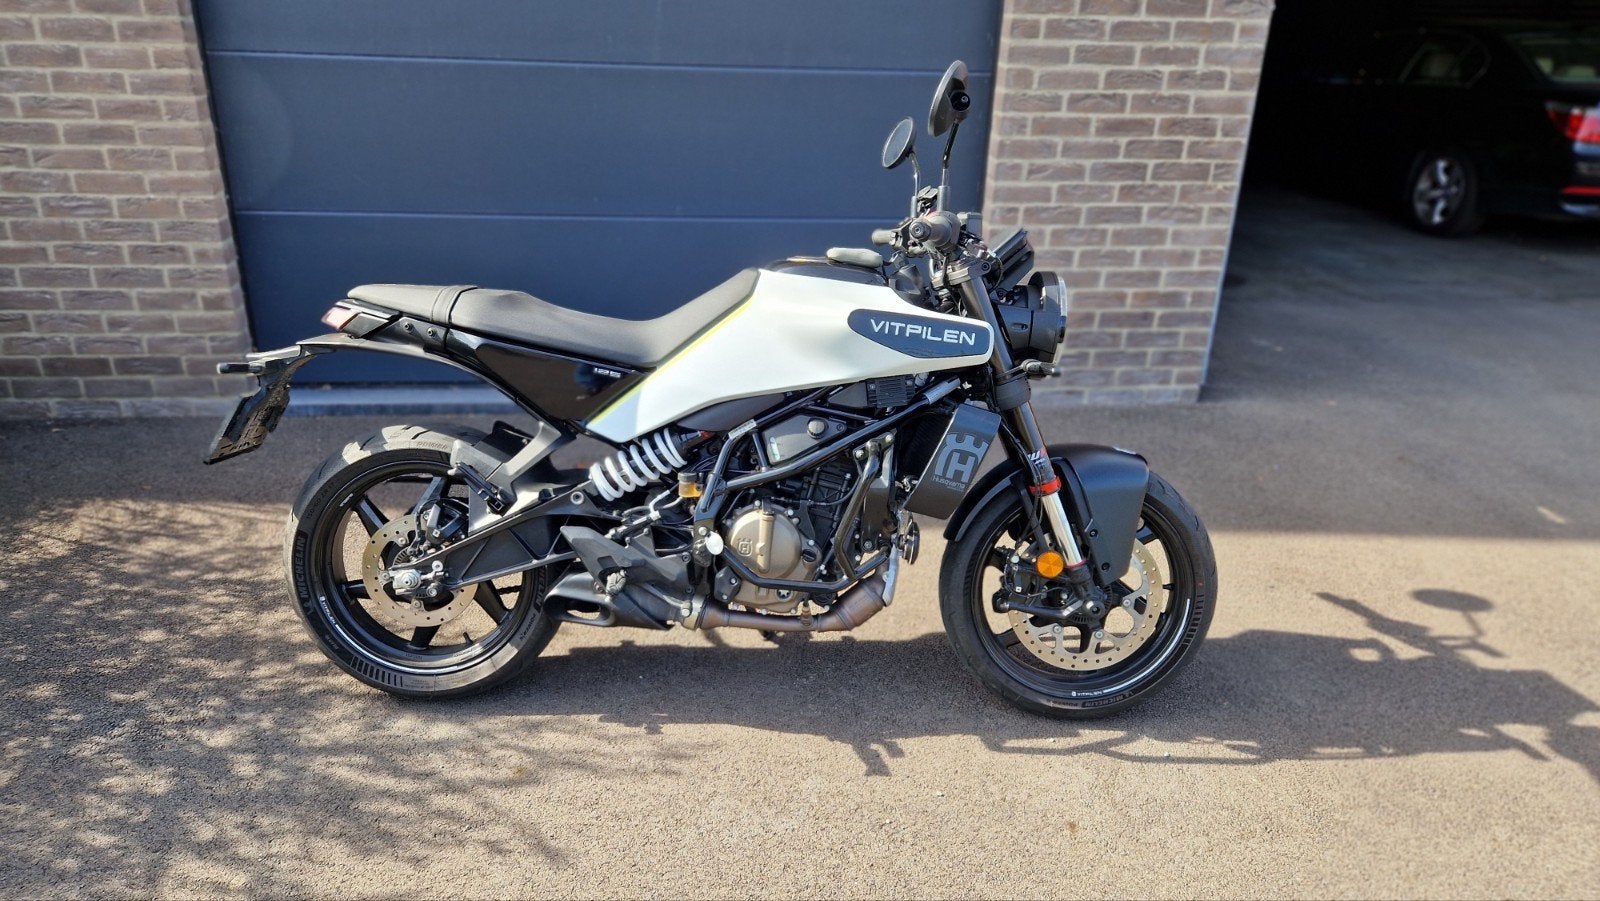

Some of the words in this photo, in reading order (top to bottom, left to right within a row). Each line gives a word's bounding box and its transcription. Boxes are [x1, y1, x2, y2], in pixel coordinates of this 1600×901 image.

[869, 318, 976, 346] VITPILEN
[933, 476, 966, 490] Husqvarna
[295, 536, 310, 599] MICHELIN
[1085, 693, 1124, 708] MICHELIN
